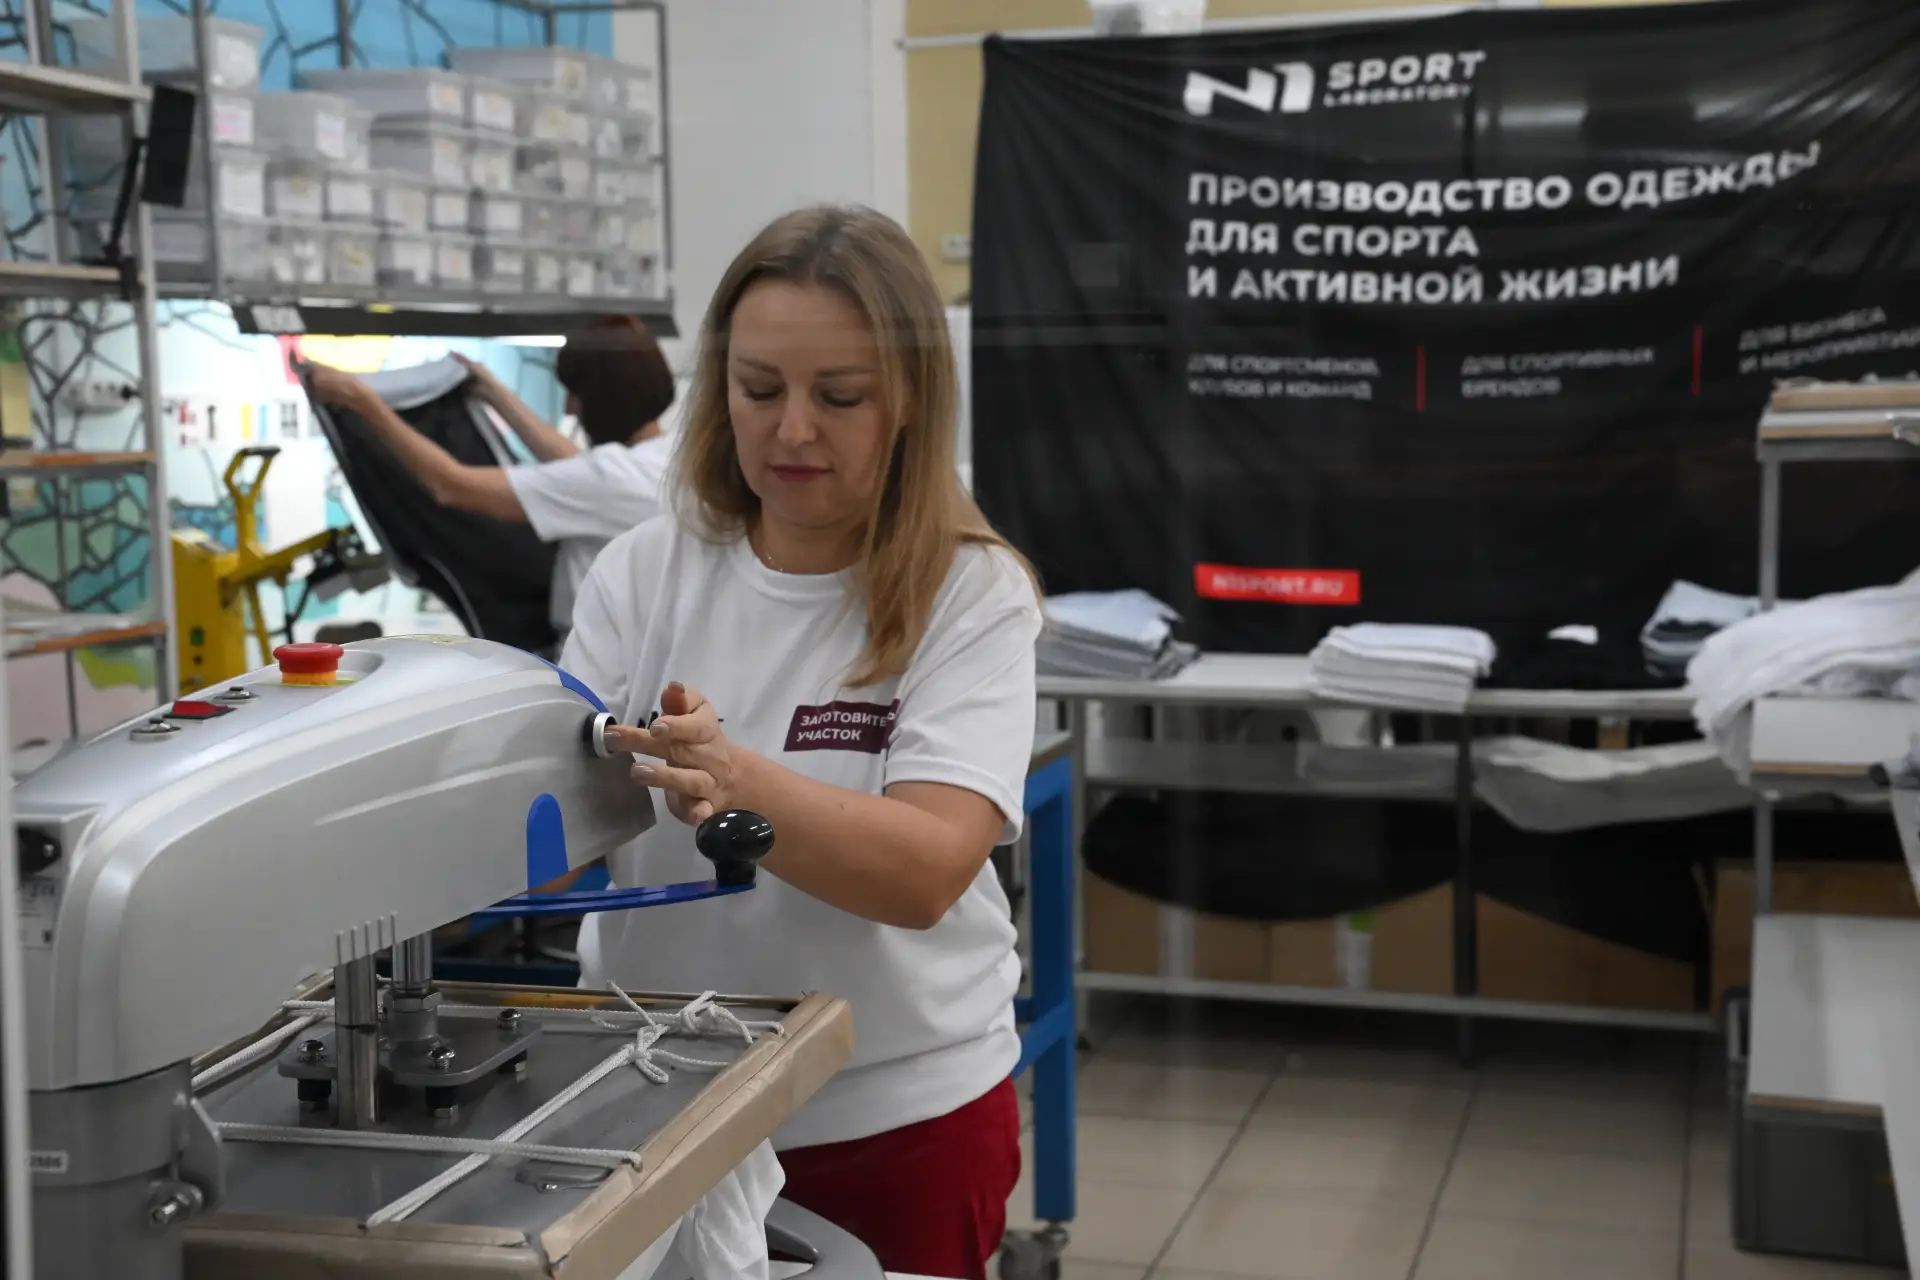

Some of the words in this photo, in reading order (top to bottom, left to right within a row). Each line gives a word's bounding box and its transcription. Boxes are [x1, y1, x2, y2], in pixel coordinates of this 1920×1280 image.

[1326, 50, 1487, 90] SPORT
[1188, 172, 1572, 217] ПРОИЗВОДСТВО
[1585, 140, 1821, 210] ОДЕЖДЫ
[1186, 219, 1279, 256] ДЛЯ
[1292, 223, 1480, 257] СПОРТА
[1188, 265, 1217, 299] И
[1231, 264, 1484, 304] АКТИВНОЙ
[1498, 253, 1680, 302] ЖИЗНИ
[796, 727, 862, 742] УЧАСТОК
